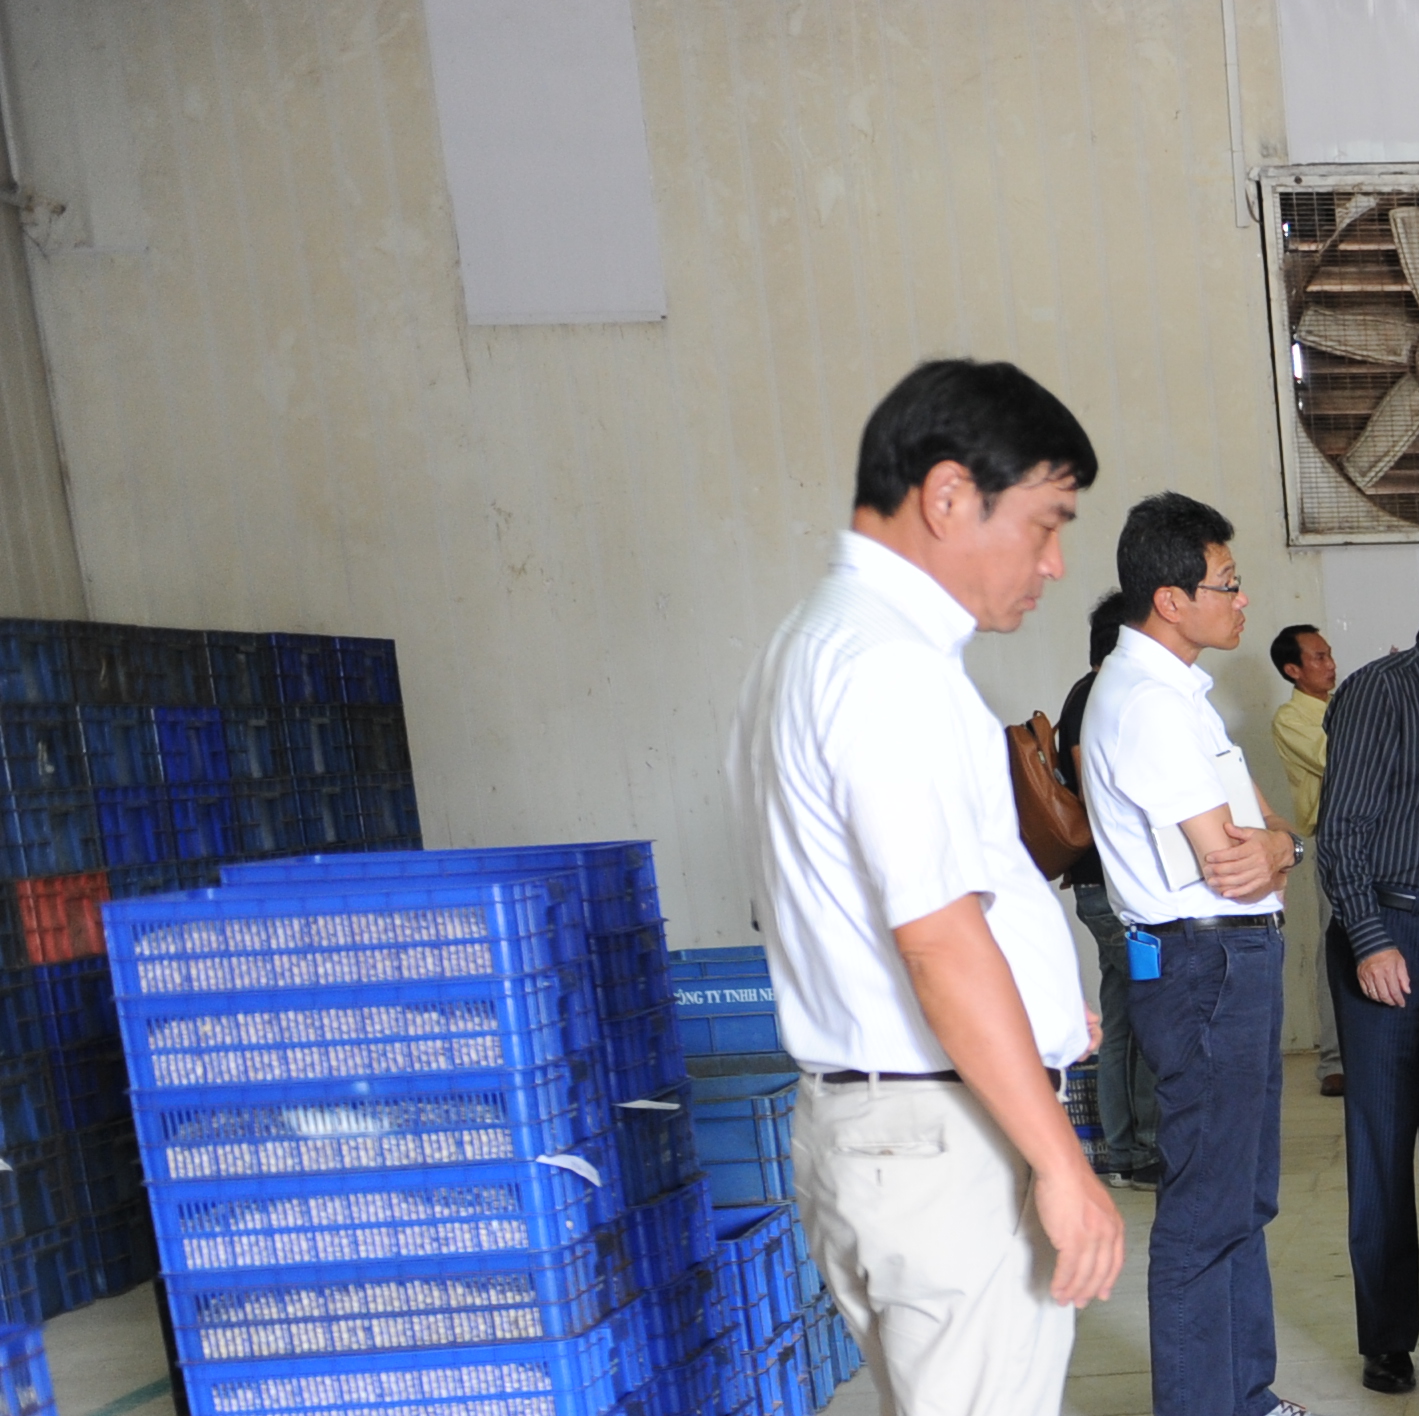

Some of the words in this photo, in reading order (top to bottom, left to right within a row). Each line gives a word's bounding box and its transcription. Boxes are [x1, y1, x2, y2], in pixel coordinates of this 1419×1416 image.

[673, 988, 704, 1006] ÔNG
[704, 989, 722, 1004] TY
[723, 988, 758, 1003] TNHH
